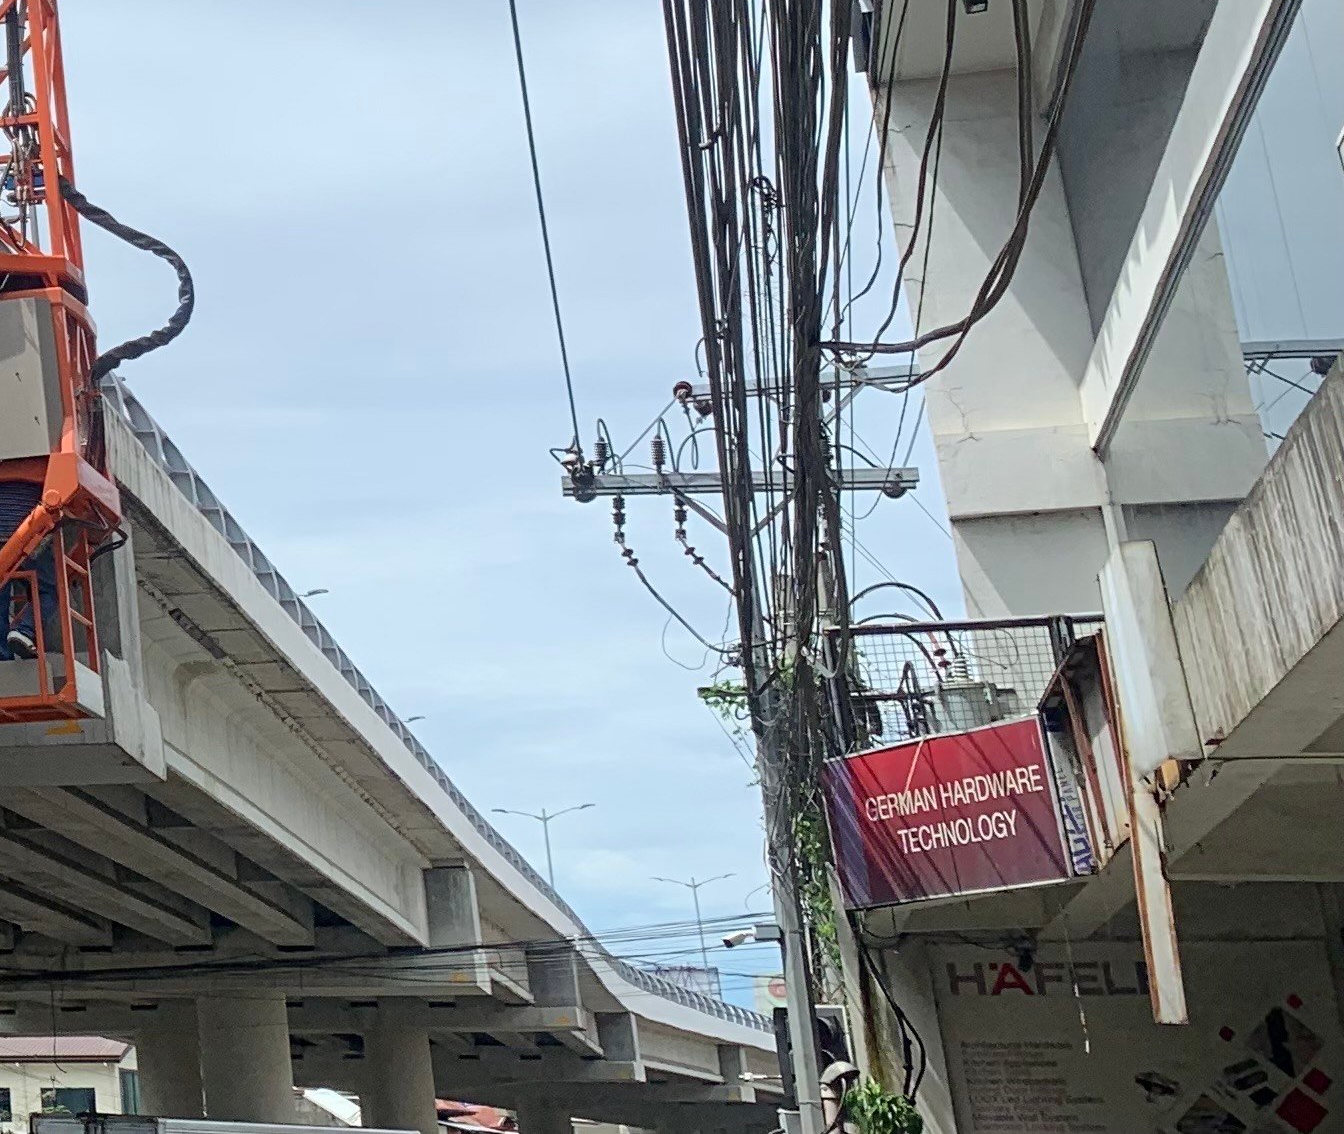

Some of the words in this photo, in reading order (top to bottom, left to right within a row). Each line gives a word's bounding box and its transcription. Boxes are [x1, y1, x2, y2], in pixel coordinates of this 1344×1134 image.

[865, 785, 938, 822] GERMAN
[938, 764, 1044, 809] HARDWARE
[897, 809, 1017, 854] TECHNOLOGY
